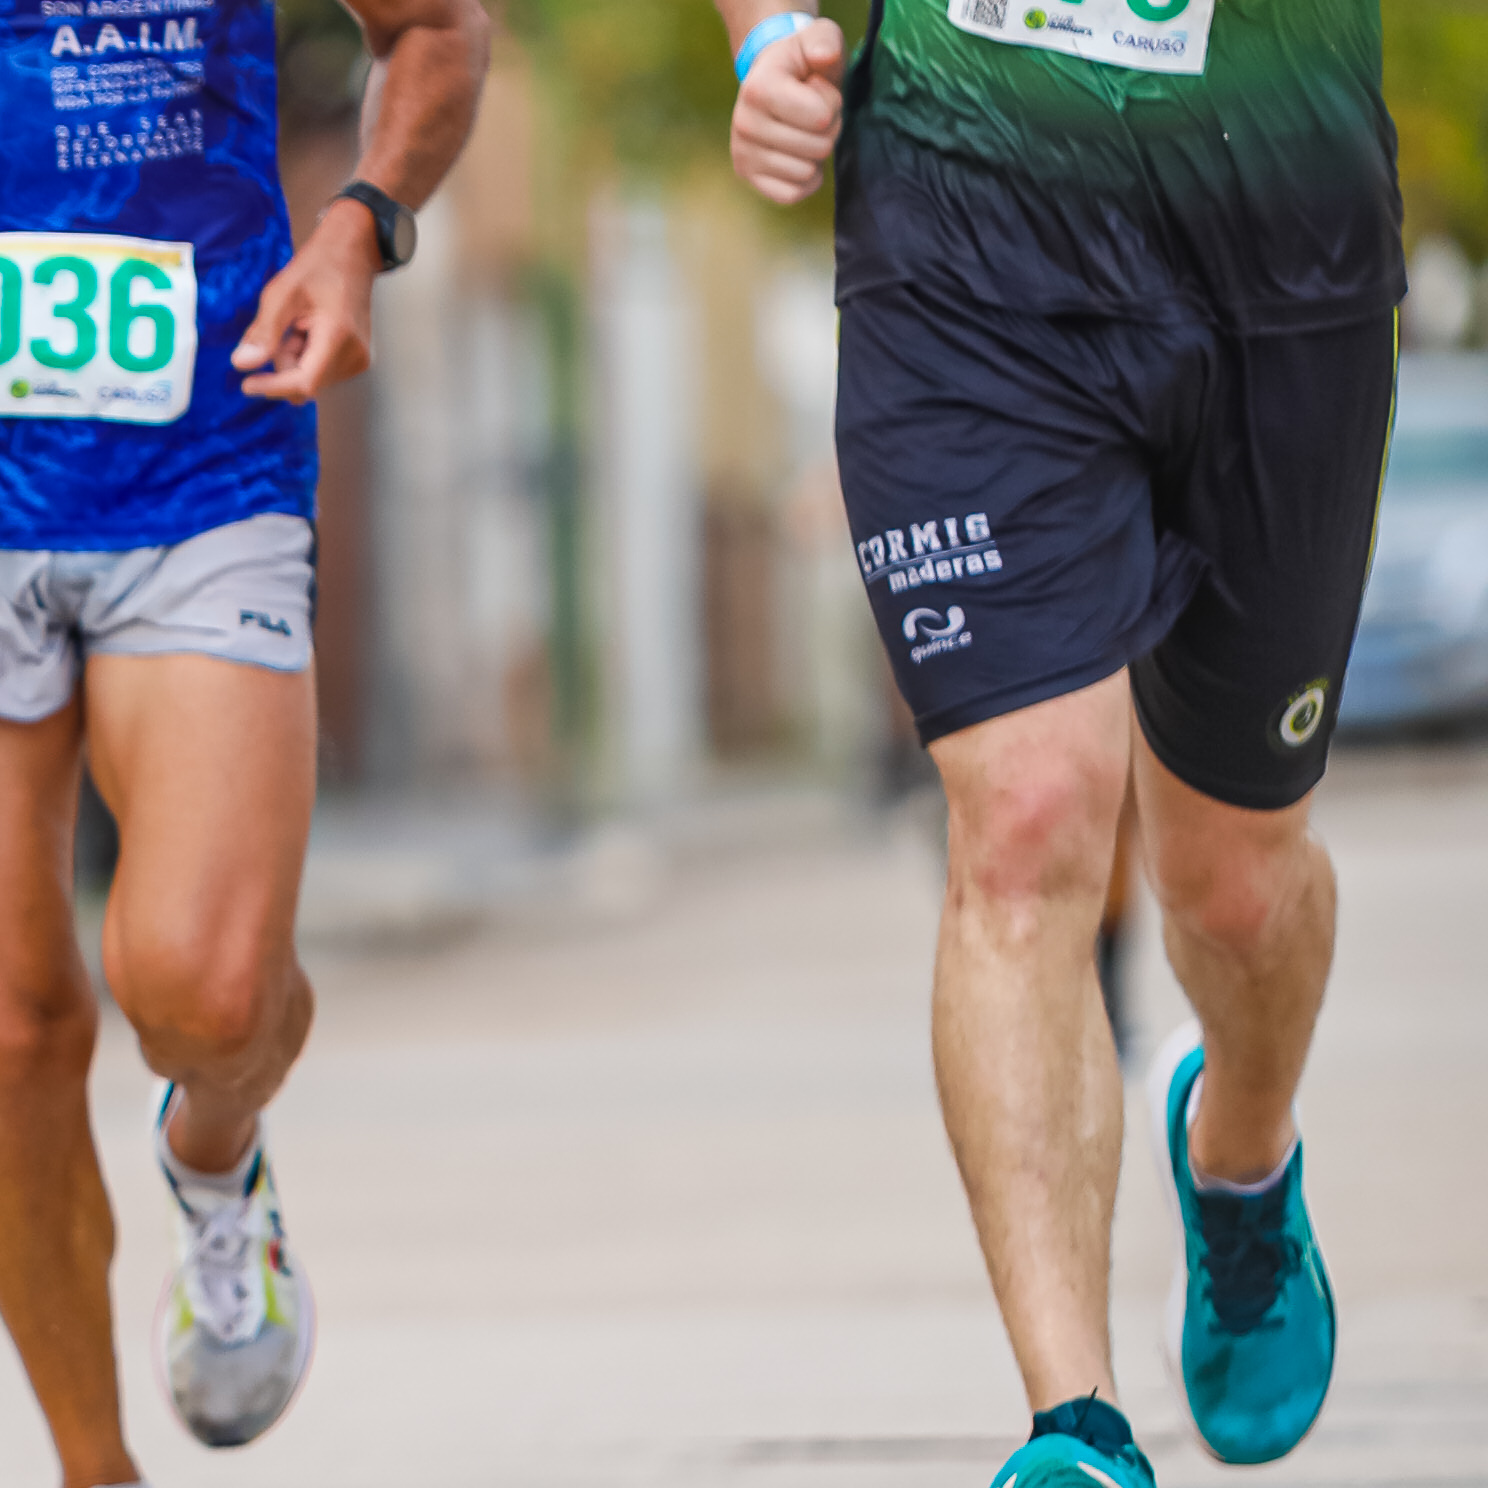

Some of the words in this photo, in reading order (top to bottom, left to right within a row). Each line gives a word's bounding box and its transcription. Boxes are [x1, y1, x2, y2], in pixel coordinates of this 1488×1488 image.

[50, 16, 204, 58] A.A.I.M.
[1112, 30, 1186, 55] CARUSO
[888, 549, 1003, 595] maderas
